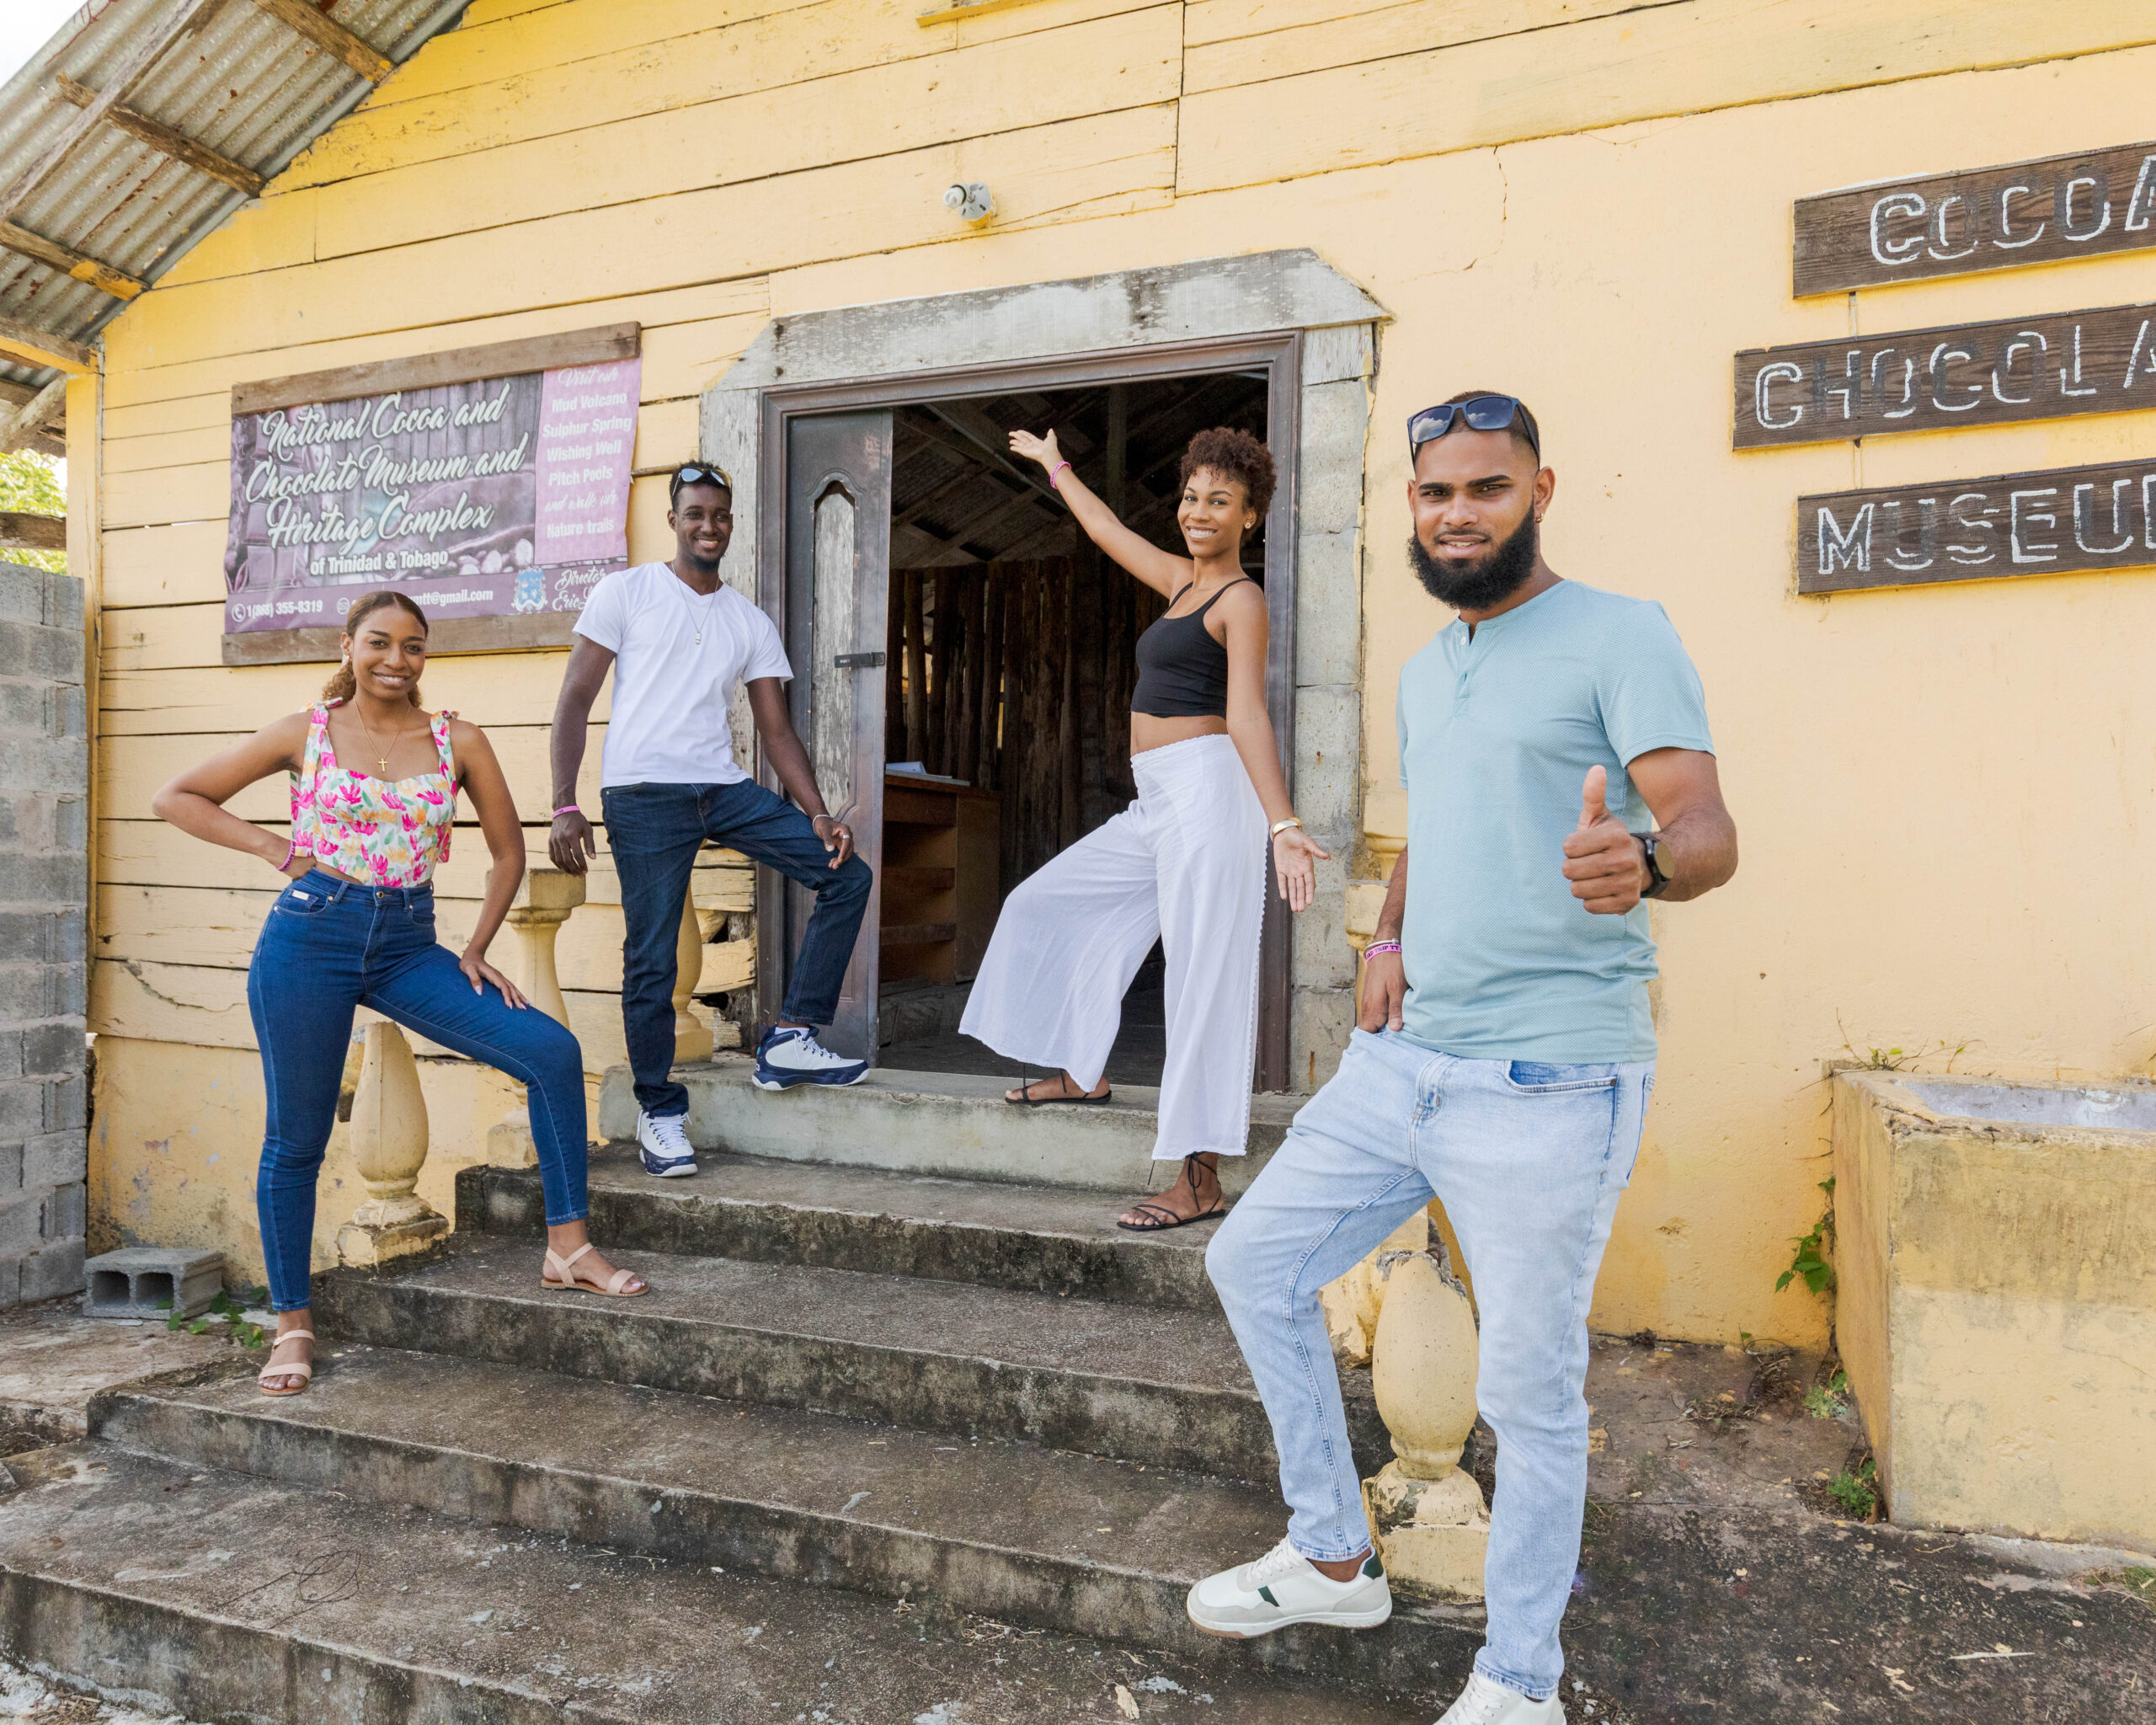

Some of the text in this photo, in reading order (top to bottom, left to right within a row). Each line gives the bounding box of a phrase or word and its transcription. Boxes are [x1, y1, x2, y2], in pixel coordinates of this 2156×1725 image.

[558, 367, 599, 387] Visit
[552, 393, 627, 413] Mud Volcano
[262, 382, 510, 462] National Cocoa and
[542, 416, 632, 438] Sulphur Spring
[547, 439, 622, 462] Wishing Well
[246, 432, 529, 503] Chocolate Museum and
[548, 465, 613, 486] Pitch Pools
[544, 494, 568, 512] and
[266, 490, 495, 555] Heritage Complex
[547, 517, 614, 539] Nature trails
[1817, 474, 2156, 575] MUSEU
[310, 550, 449, 575] of Trinidad & Tobago
[554, 565, 606, 591] Director
[275, 599, 323, 616] 355-8319
